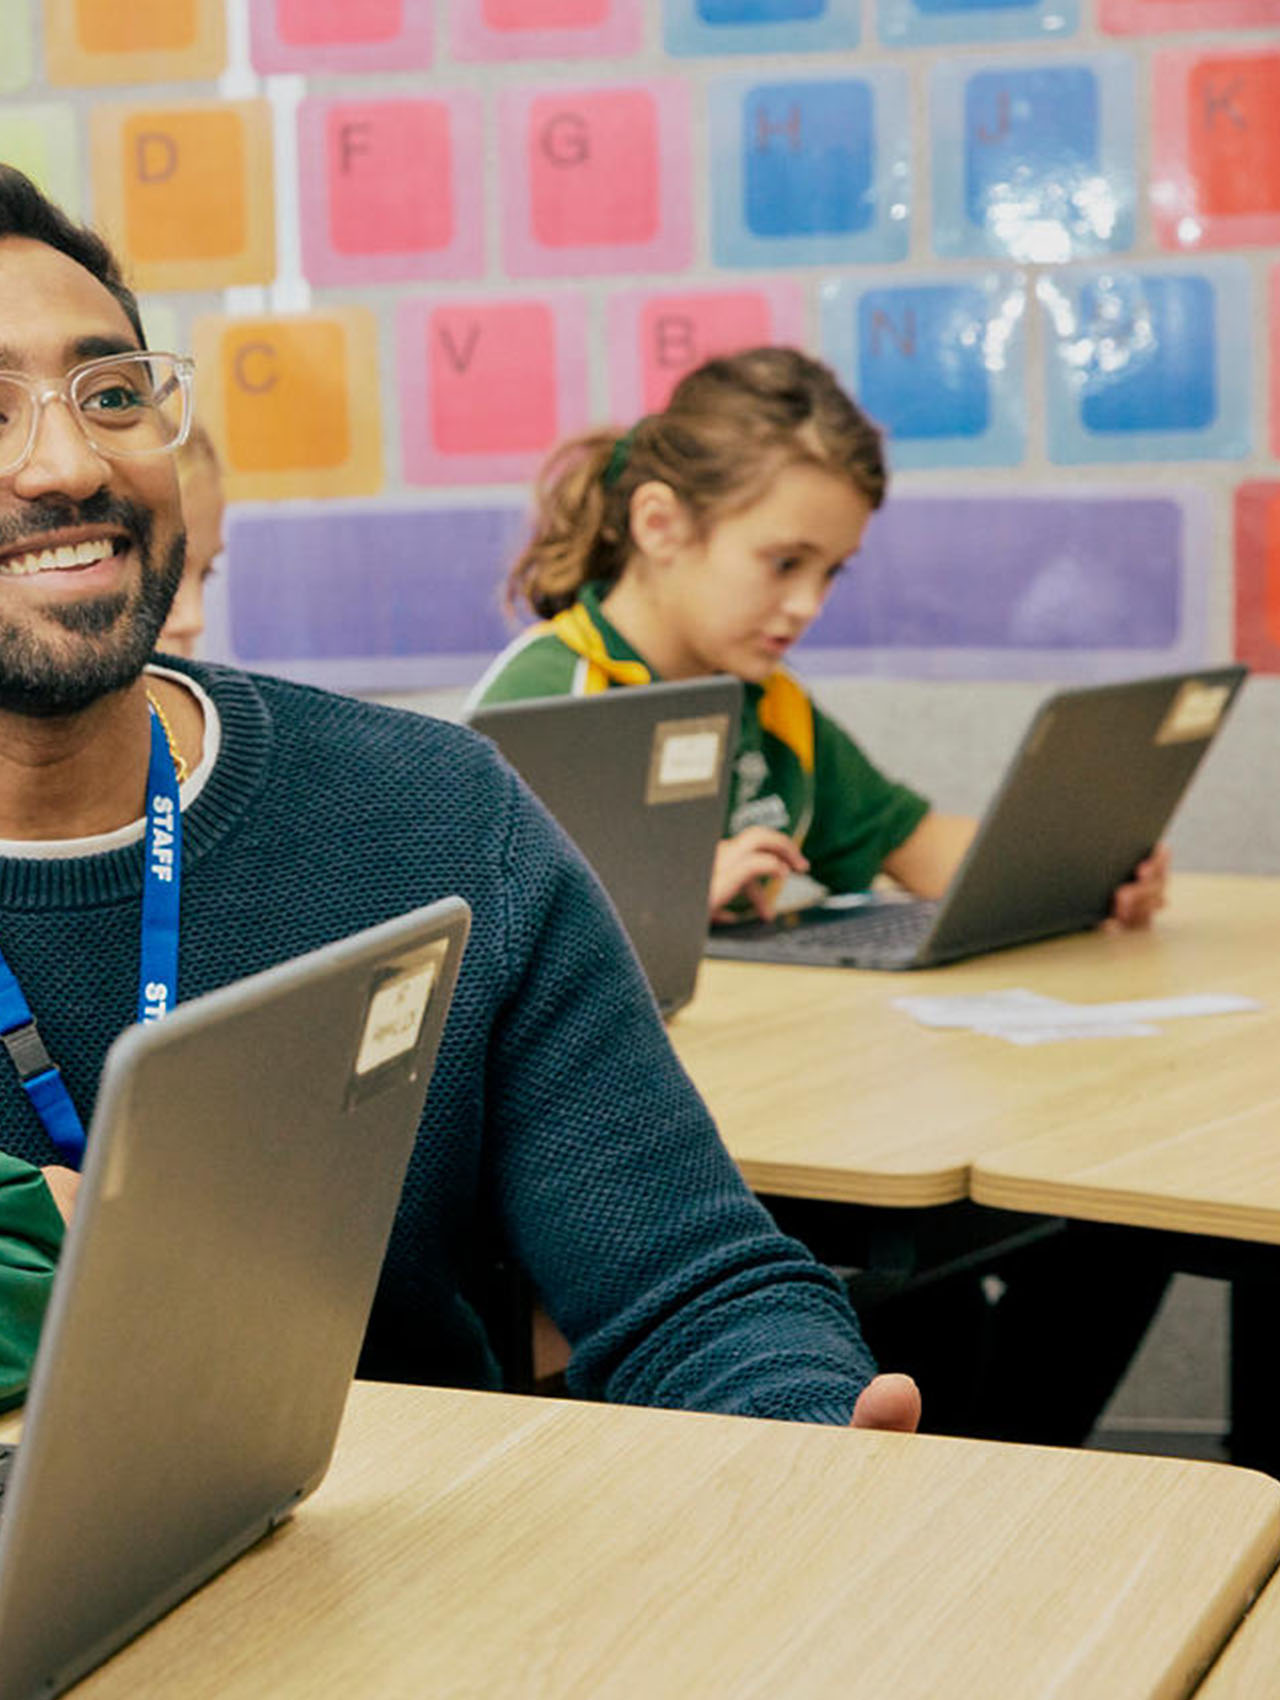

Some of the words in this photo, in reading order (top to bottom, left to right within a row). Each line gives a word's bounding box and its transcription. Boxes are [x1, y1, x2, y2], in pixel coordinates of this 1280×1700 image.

[755, 106, 803, 155] H
[977, 92, 1011, 145] J
[1202, 79, 1248, 132] K
[134, 132, 179, 185] D
[338, 122, 372, 175] F
[540, 113, 591, 170] G
[439, 322, 481, 375] V
[655, 316, 697, 369] B
[869, 307, 917, 358] N
[233, 342, 280, 396] C
[152, 794, 175, 882] STAFF
